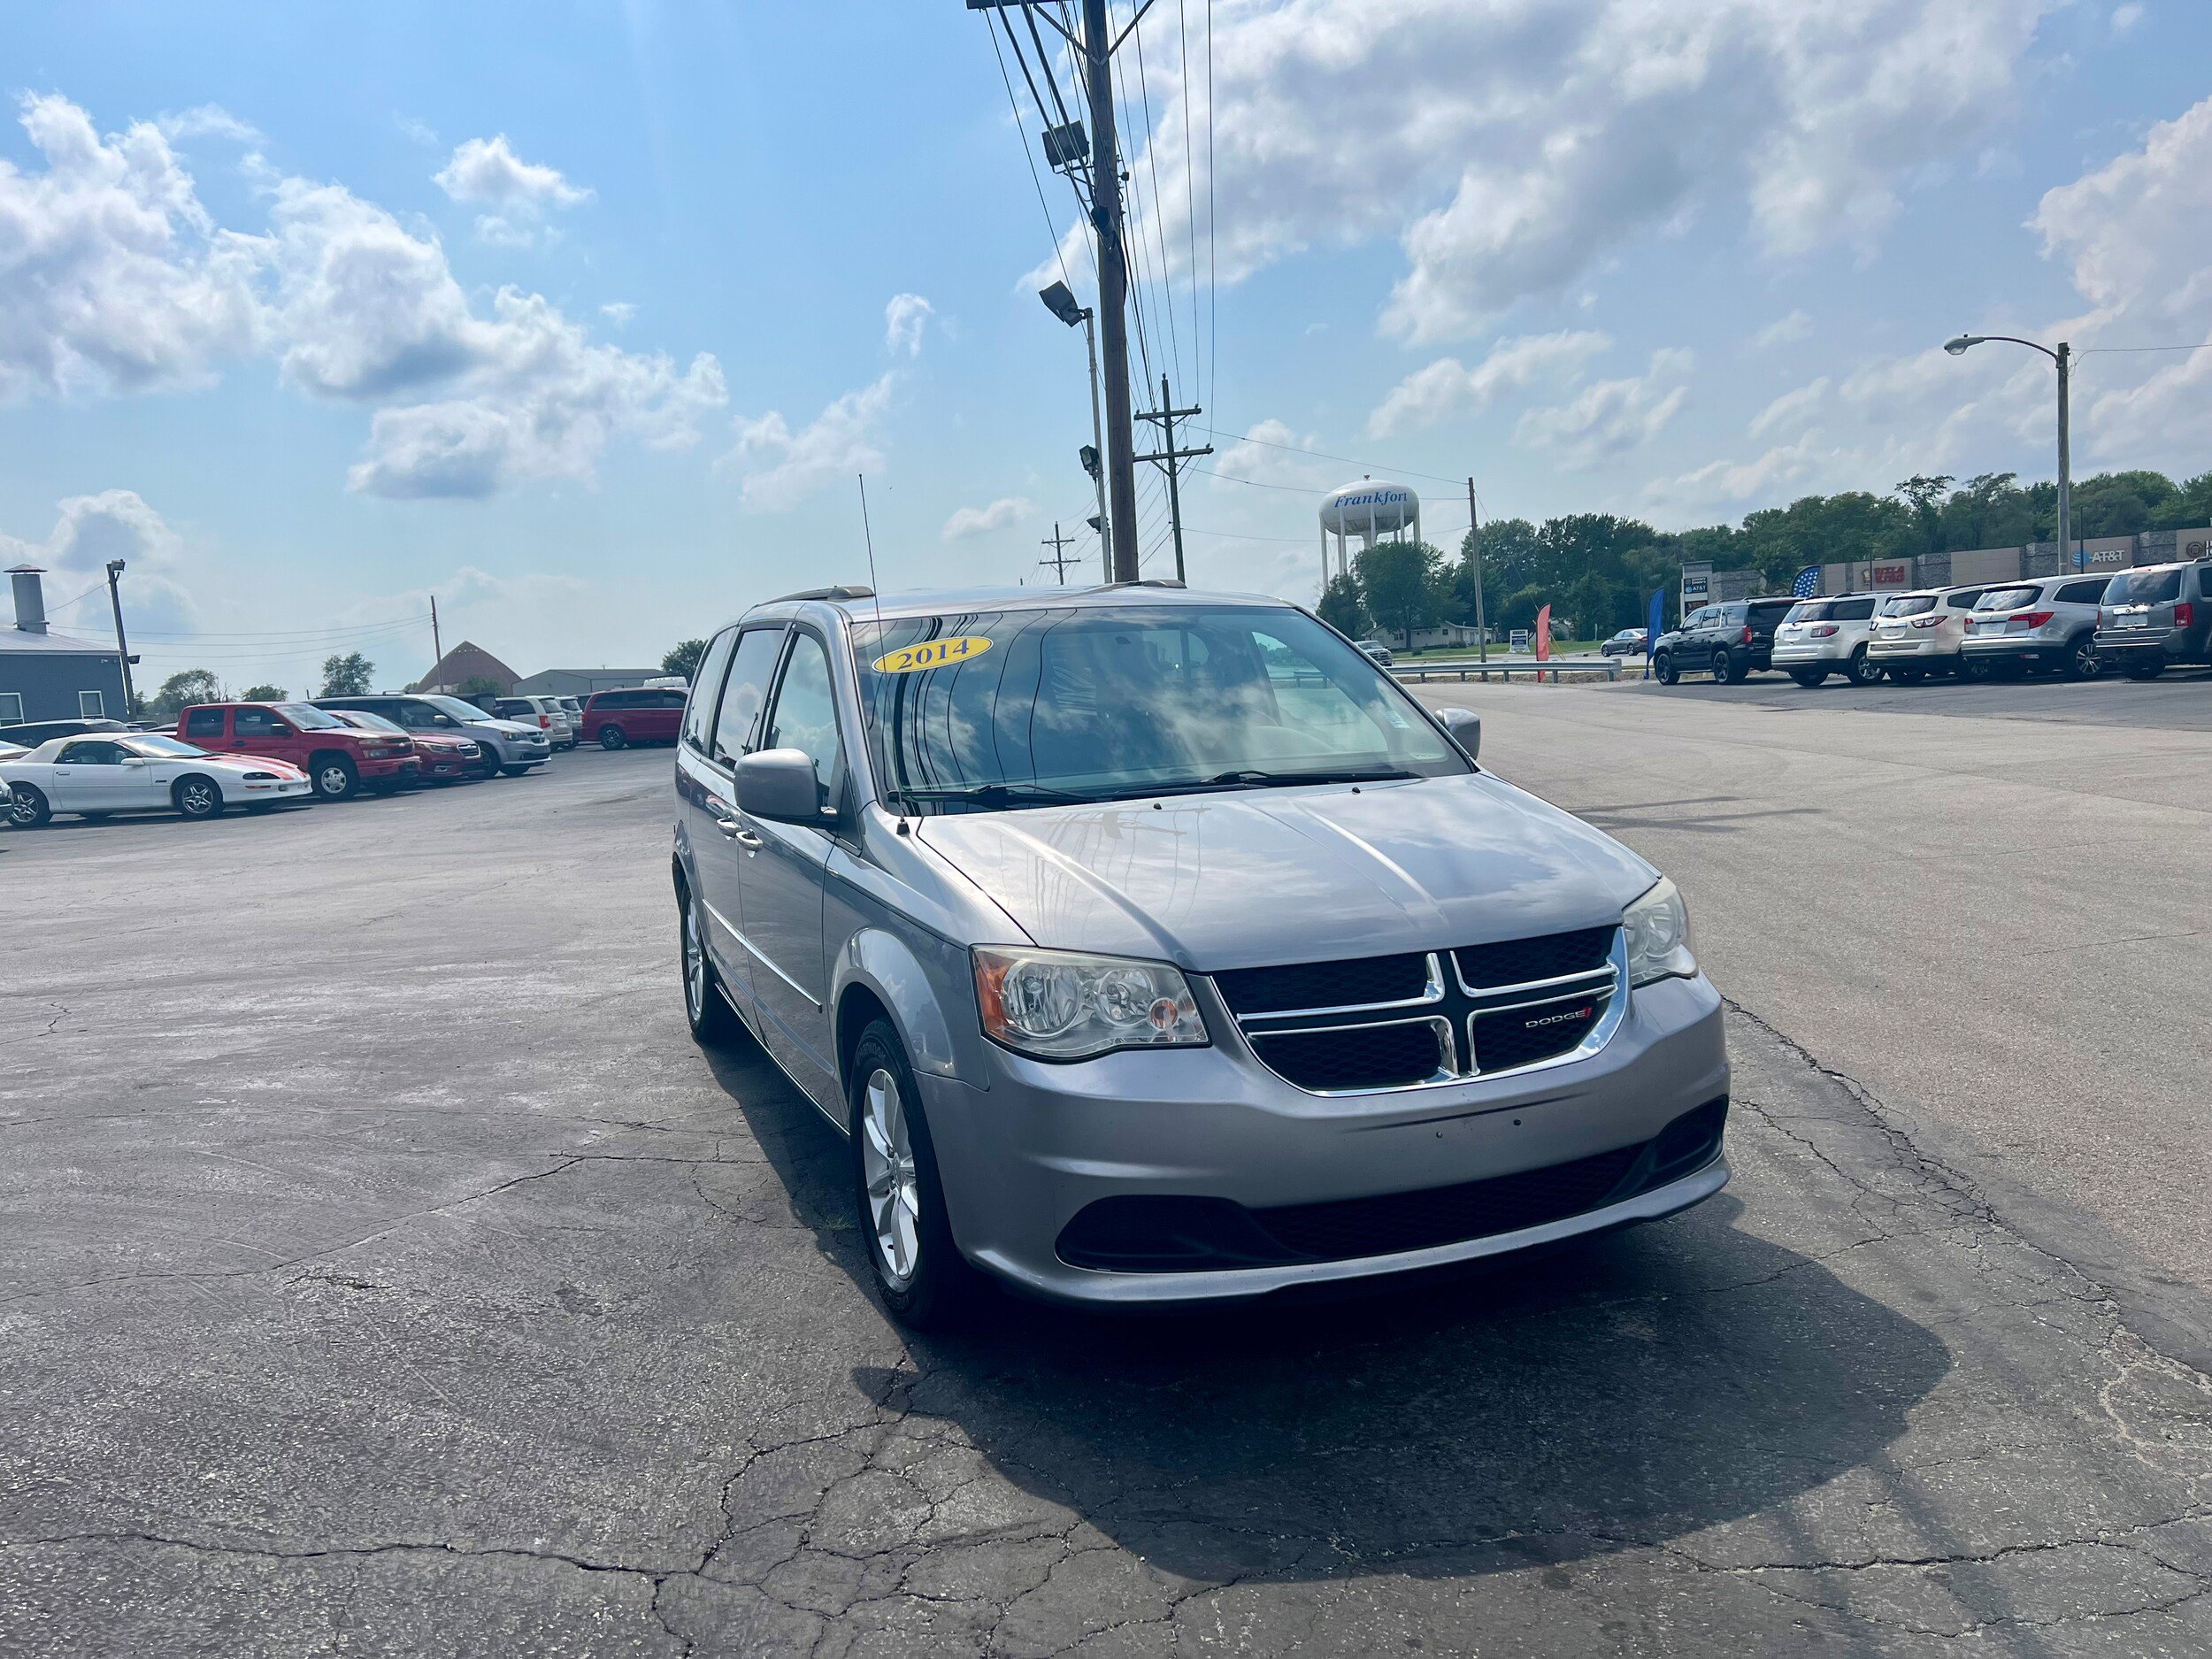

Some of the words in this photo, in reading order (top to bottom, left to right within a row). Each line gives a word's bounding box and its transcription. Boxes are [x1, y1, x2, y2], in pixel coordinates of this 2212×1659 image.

[1334, 490, 1408, 508] Frankfort
[2092, 549, 2125, 563] AT&T
[897, 638, 970, 670] 2014
[1525, 1009, 1586, 1028] DODGE
